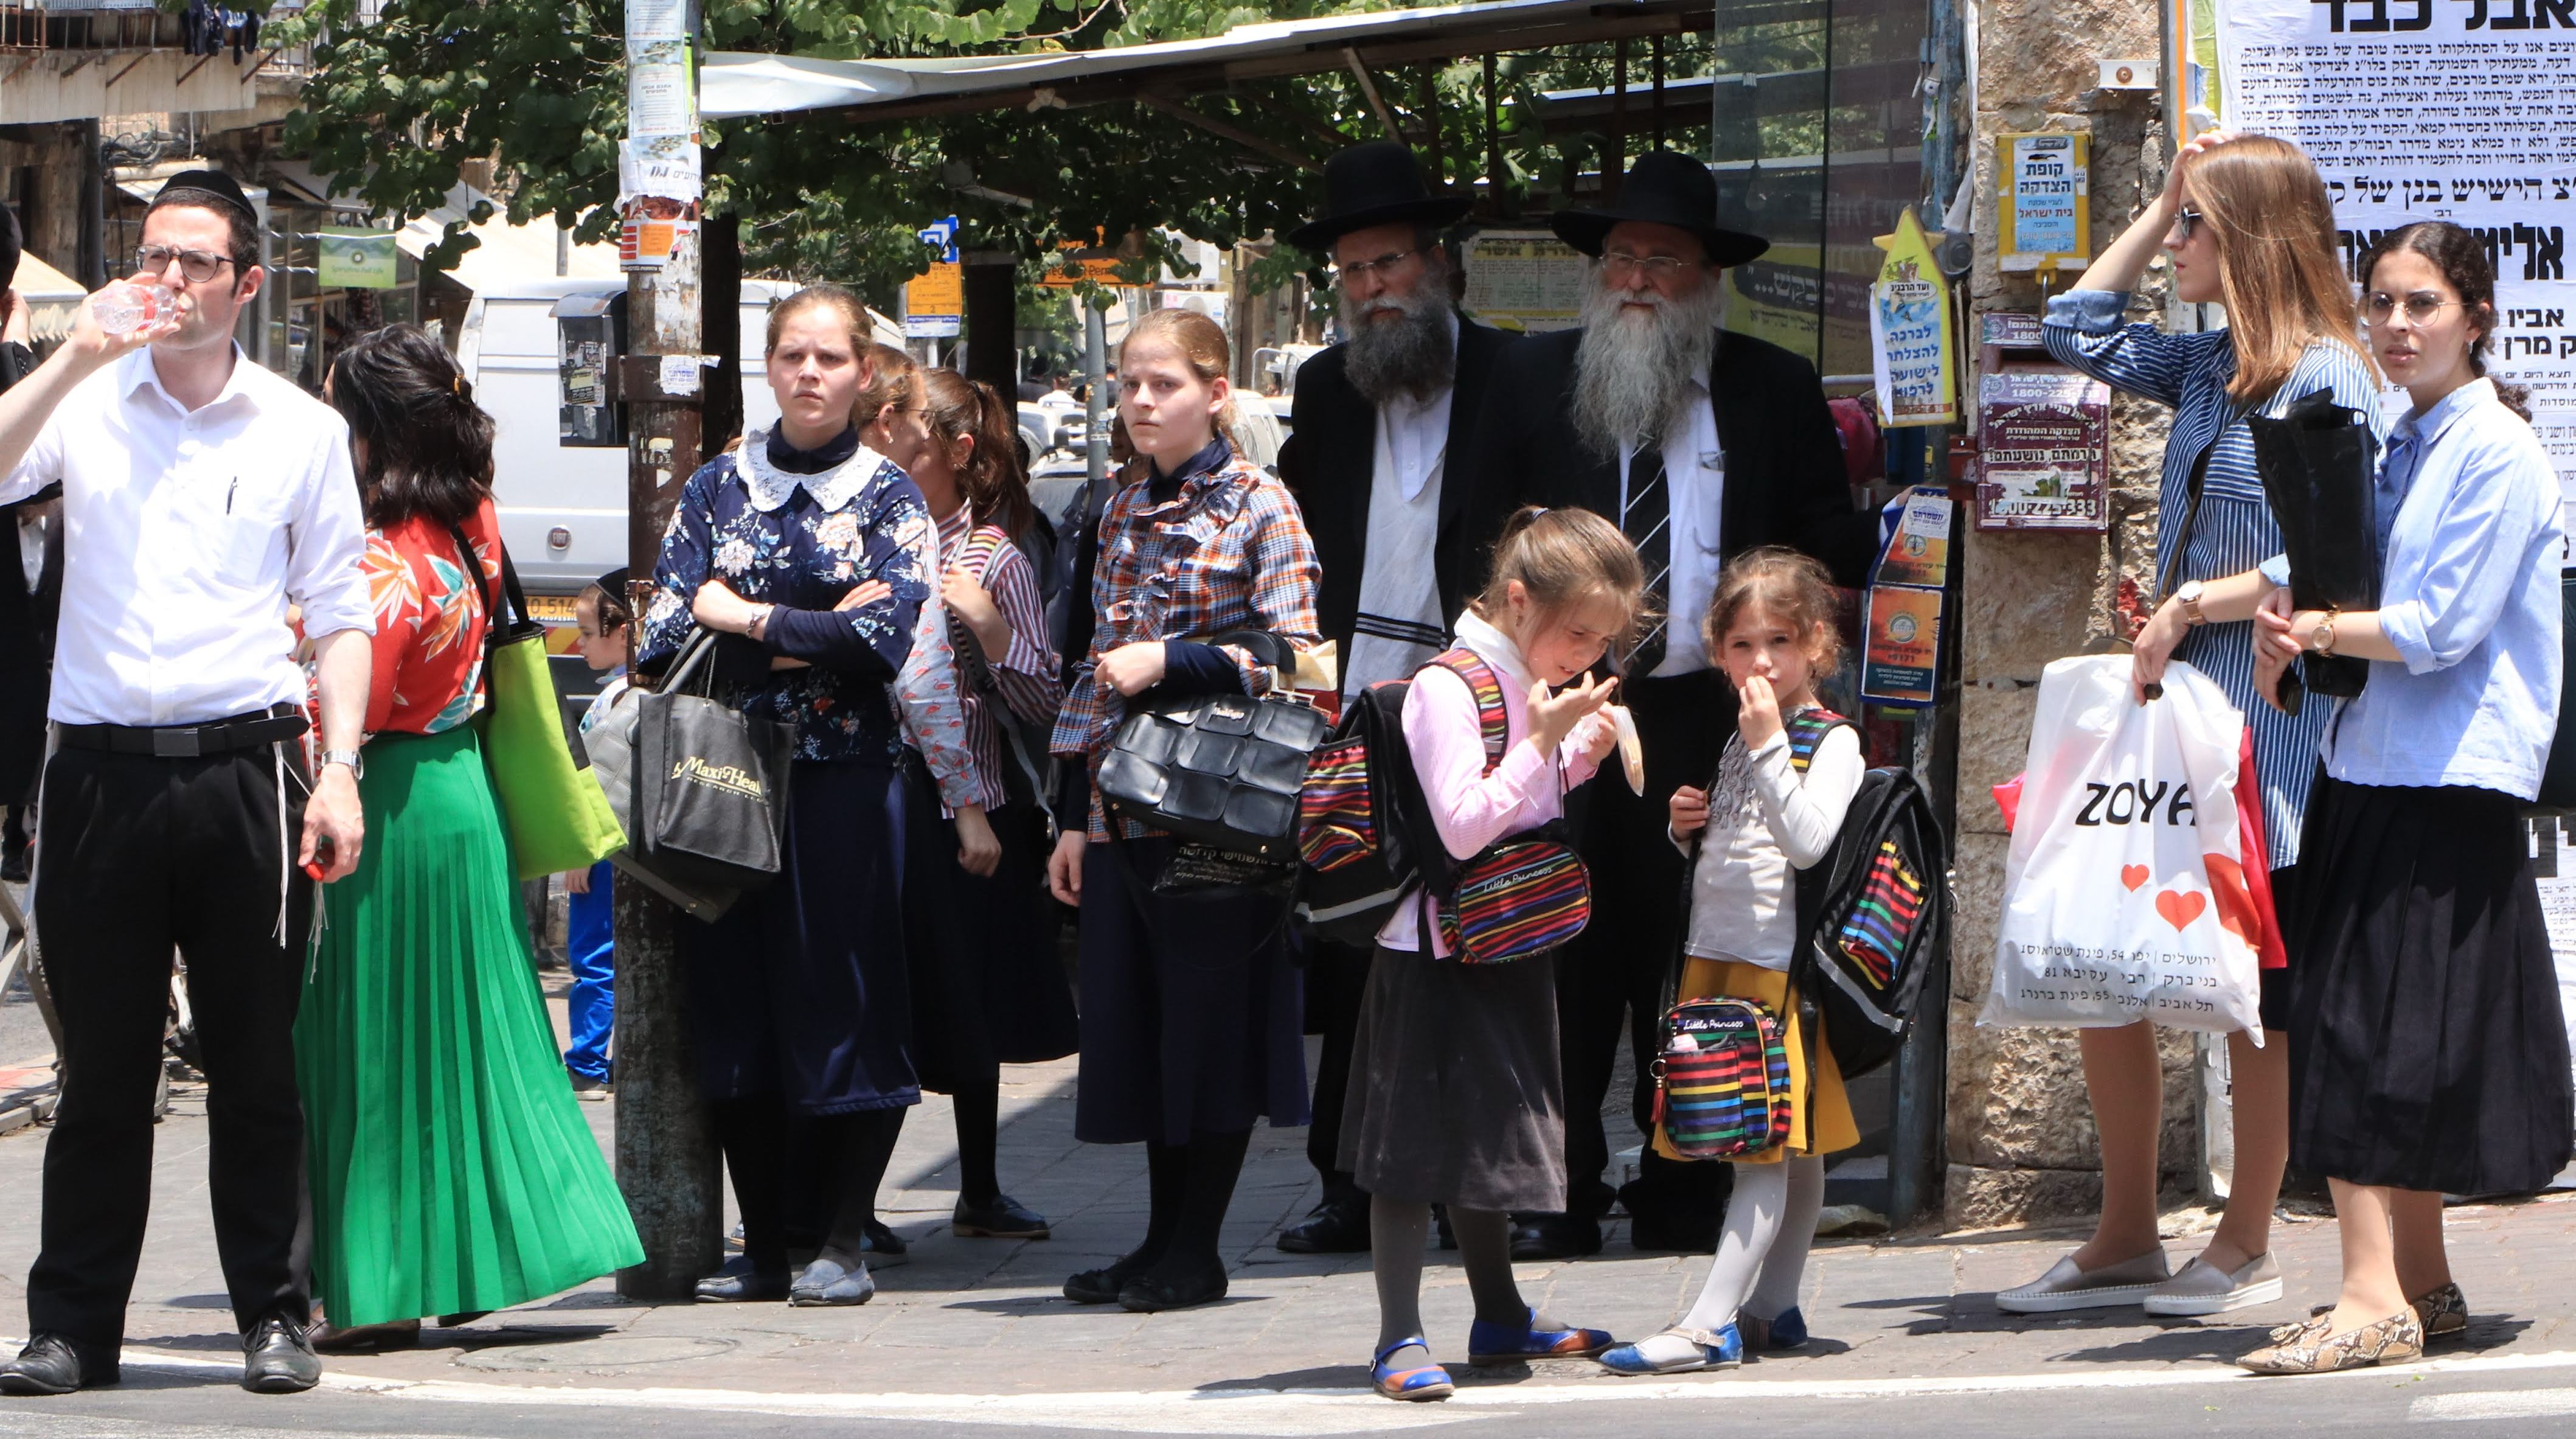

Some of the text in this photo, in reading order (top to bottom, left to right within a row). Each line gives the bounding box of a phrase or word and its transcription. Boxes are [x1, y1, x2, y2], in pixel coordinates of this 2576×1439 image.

[2282, 46, 2298, 58] נקי
[2305, 46, 2327, 56] נפש
[2334, 43, 2352, 57] של
[2358, 44, 2387, 56] טובה
[2394, 44, 2431, 55] בשיבה
[2438, 40, 2498, 55] הסתלקותו
[2504, 40, 2518, 54] על
[2525, 42, 2543, 52] אנו
[2241, 46, 2276, 61] וצדיק,
[2241, 60, 2271, 72] ודולה
[2278, 61, 2303, 72] אמת
[2309, 58, 2349, 75] לצדיקי
[2392, 60, 2420, 72] דבוק
[2426, 59, 2478, 71] השמועה,
[2485, 58, 2536, 71] ממעתיקי
[2543, 57, 2570, 70] דעה,
[2241, 78, 2269, 89] הזעם
[2274, 78, 2310, 89] בשנות
[2314, 74, 2362, 89] התרעלה
[2368, 77, 2387, 87] כוס
[2392, 76, 2409, 88] את
[2414, 75, 2441, 86] שתה
[2446, 74, 2487, 89] מרבים,
[2491, 74, 2523, 85] שמים
[2529, 74, 2548, 83] ירא
[2242, 95, 2254, 104] כל
[2260, 91, 2307, 106] ולבריות,
[2313, 90, 2353, 104] לשמים
[2359, 92, 2372, 102] נח
[2378, 89, 2428, 104] ואצילות,
[2434, 88, 2467, 102] נעלות
[2474, 90, 2513, 102] מדותיו
[2519, 89, 2553, 102] הנפש,
[2242, 111, 2262, 120] קונו
[2268, 110, 2283, 120] עם
[2288, 108, 2338, 120] המתחסד
[2344, 108, 2379, 120] אמיתי
[2384, 108, 2412, 118] חסיד
[2418, 106, 2459, 119] טהורה,
[2465, 106, 2499, 117] אמונה
[2505, 103, 2522, 118] של
[2527, 105, 2553, 115] אחת
[2269, 125, 2321, 136] כבחמורה
[2325, 122, 2348, 138] קלה
[2352, 121, 2367, 136] על
[2371, 124, 2408, 135] הקפיד
[2412, 122, 2445, 135] קמאי,
[2449, 122, 2490, 134] כחסידי
[2494, 119, 2545, 134] תפילותיו
[2301, 138, 2342, 152] תלמידי
[2350, 139, 2392, 152] רבוה"ק
[2400, 139, 2430, 151] מדרך
[2438, 139, 2465, 150] נימא
[2472, 135, 2504, 148] כמלא
[2512, 138, 2521, 147] זז
[2529, 134, 2548, 147] ולא
[2343, 156, 2376, 167] יראים
[2381, 155, 2414, 166] דורות
[2418, 152, 2462, 166] להעמיד
[2467, 154, 2491, 164] וזכה
[2495, 153, 2525, 164] בחייו
[2529, 153, 2552, 163] ראה
[2026, 163, 2064, 177] קופת
[2019, 181, 2071, 195] הצדקה
[2354, 175, 2394, 203] של
[2452, 178, 2543, 202] הישיש
[2403, 179, 2443, 211] בנן
[2019, 207, 2074, 218] בית ישראל
[2508, 308, 2564, 327] אביו
[1890, 324, 1931, 342] לברכה
[2504, 336, 2552, 360] מרן
[1892, 382, 1934, 397] לרפוא
[2049, 427, 2081, 436] הצדקה
[2075, 779, 2196, 826] ZOYA
[1484, 866, 1553, 893] Little Princess
[2077, 948, 2103, 959] פינת
[2131, 952, 2150, 961] יפו
[2162, 953, 2217, 965] ירושלים
[2044, 967, 2217, 988] בני ברק רבי עקיבא 81
[2060, 991, 2088, 1002] פינת
[2114, 993, 2148, 1007] אלנבי
[2160, 997, 2196, 1011] אביב
[2196, 997, 2214, 1012] תל
[1683, 1018, 1745, 1031] Little Princess
